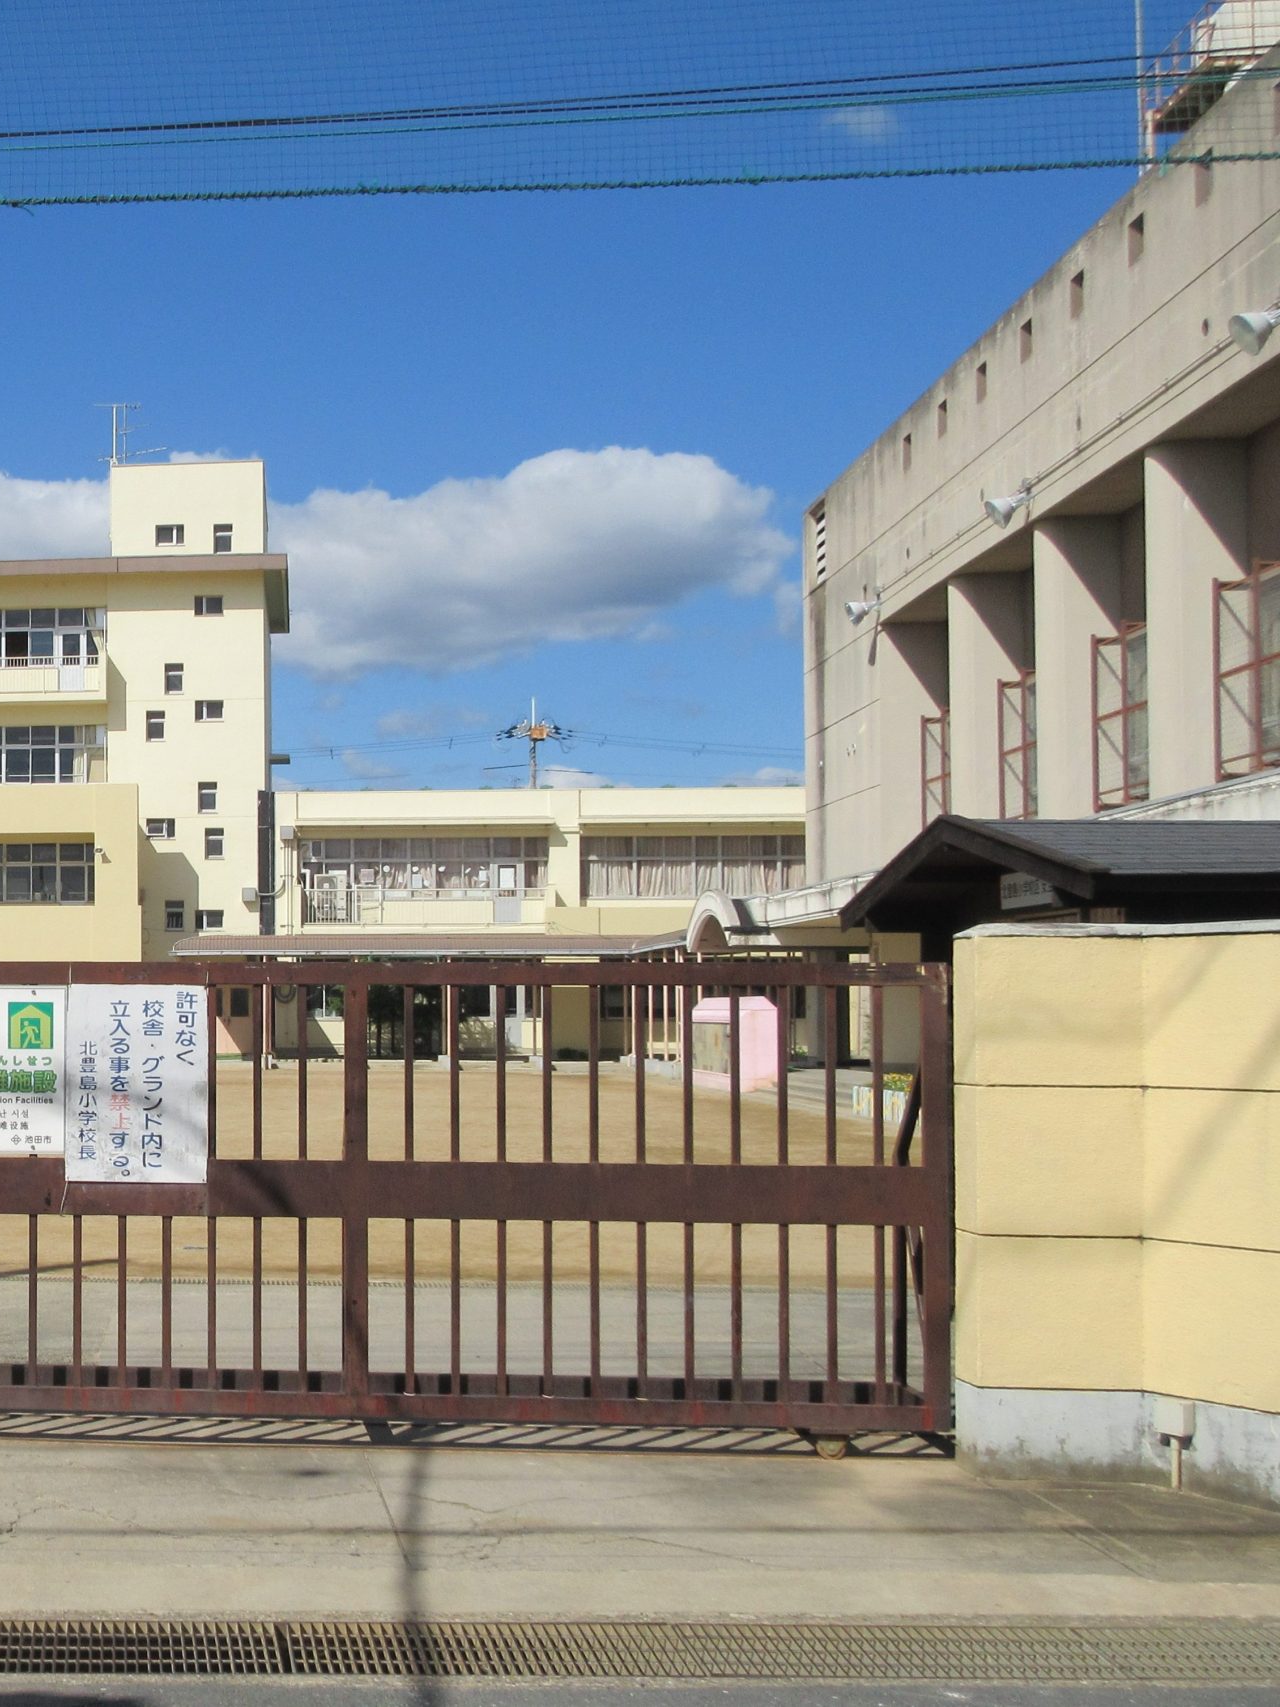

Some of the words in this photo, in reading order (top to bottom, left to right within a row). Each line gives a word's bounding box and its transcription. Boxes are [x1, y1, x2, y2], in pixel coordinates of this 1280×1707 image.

[175, 991, 198, 1066] 許可なく
[15, 1096, 54, 1105] Facilities
[78, 1040, 97, 1161] 北豊島小学校長
[141, 999, 165, 1168] 校舎・グランド内に
[11, 1108, 29, 1119] 시설
[24, 1134, 52, 1145] 池田市
